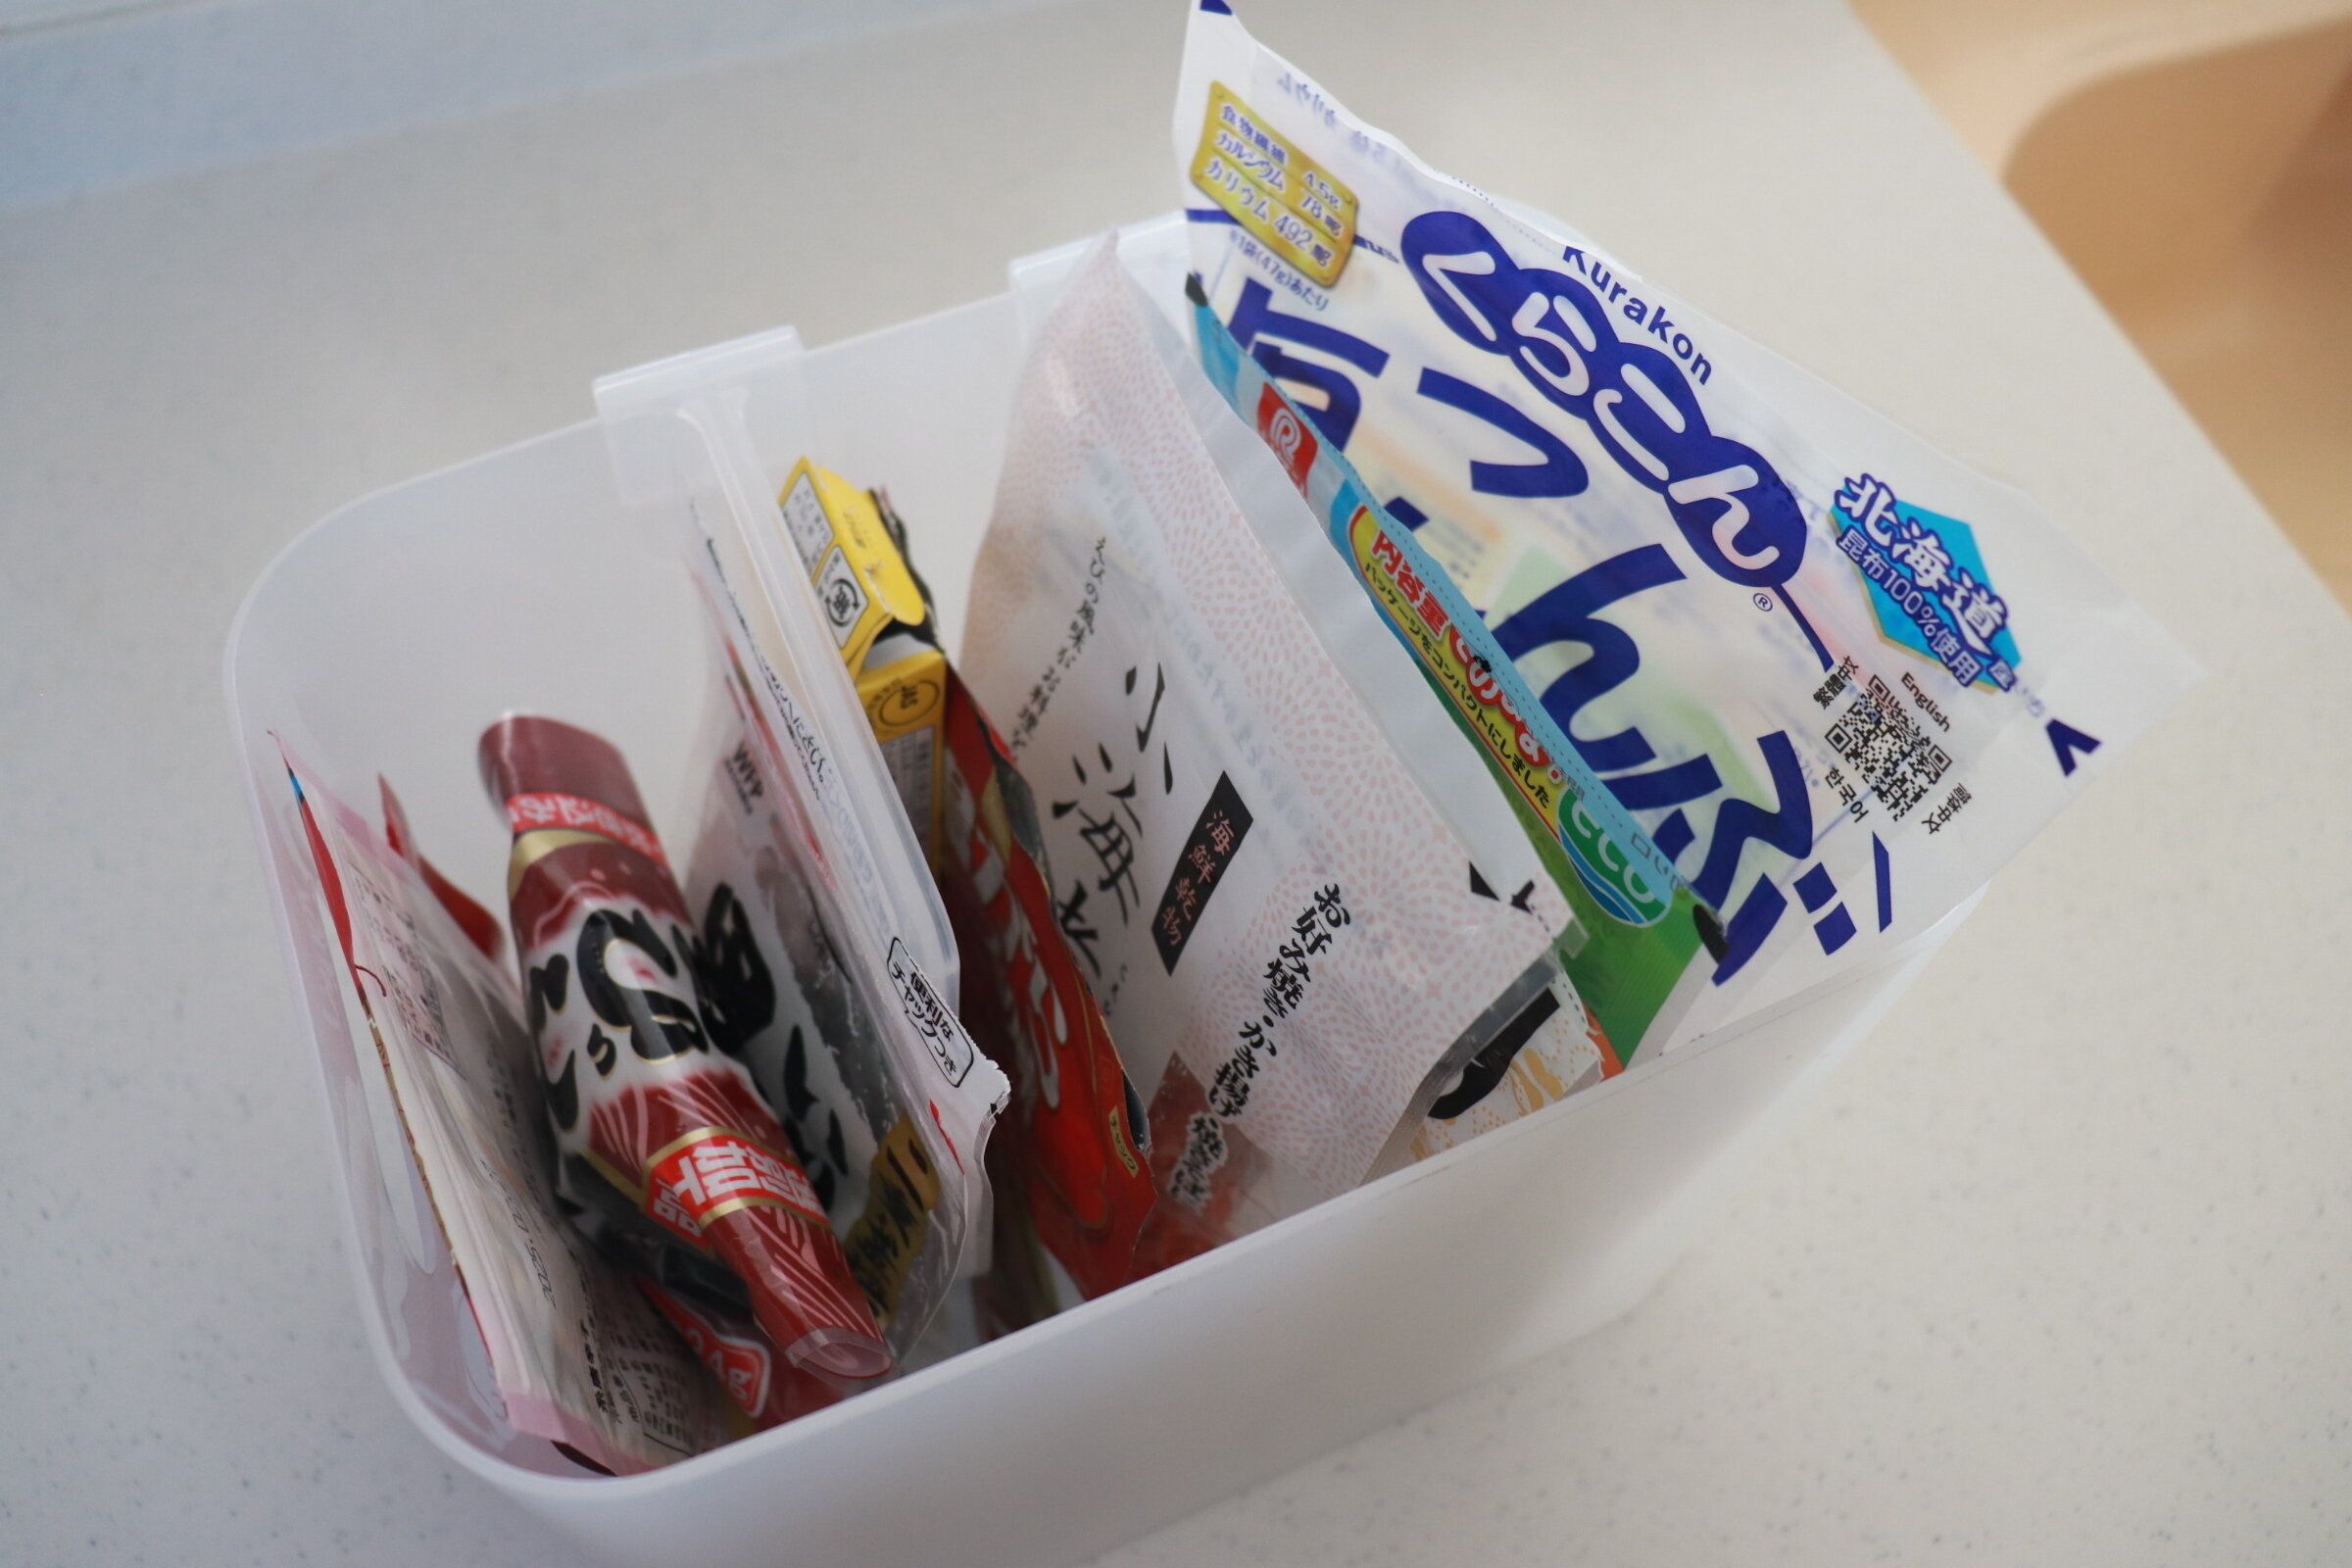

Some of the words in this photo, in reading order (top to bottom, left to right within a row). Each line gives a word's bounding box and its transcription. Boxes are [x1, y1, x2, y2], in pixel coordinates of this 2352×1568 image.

[1207, 158, 1269, 222] カリウム
[1217, 132, 1283, 191] カルシウム
[1562, 246, 1713, 385] Kurakon
[1422, 251, 1780, 570] くらこん
[1838, 528, 1982, 686] 昆布100%使用
[1813, 656, 1860, 710] 繁體中文
[1902, 673, 1950, 732] English
[1826, 767, 1870, 823] 한국어
[1921, 782, 1973, 835] 简体中文
[890, 961, 957, 1076] チャックつき
[909, 971, 954, 1041] 便利な
